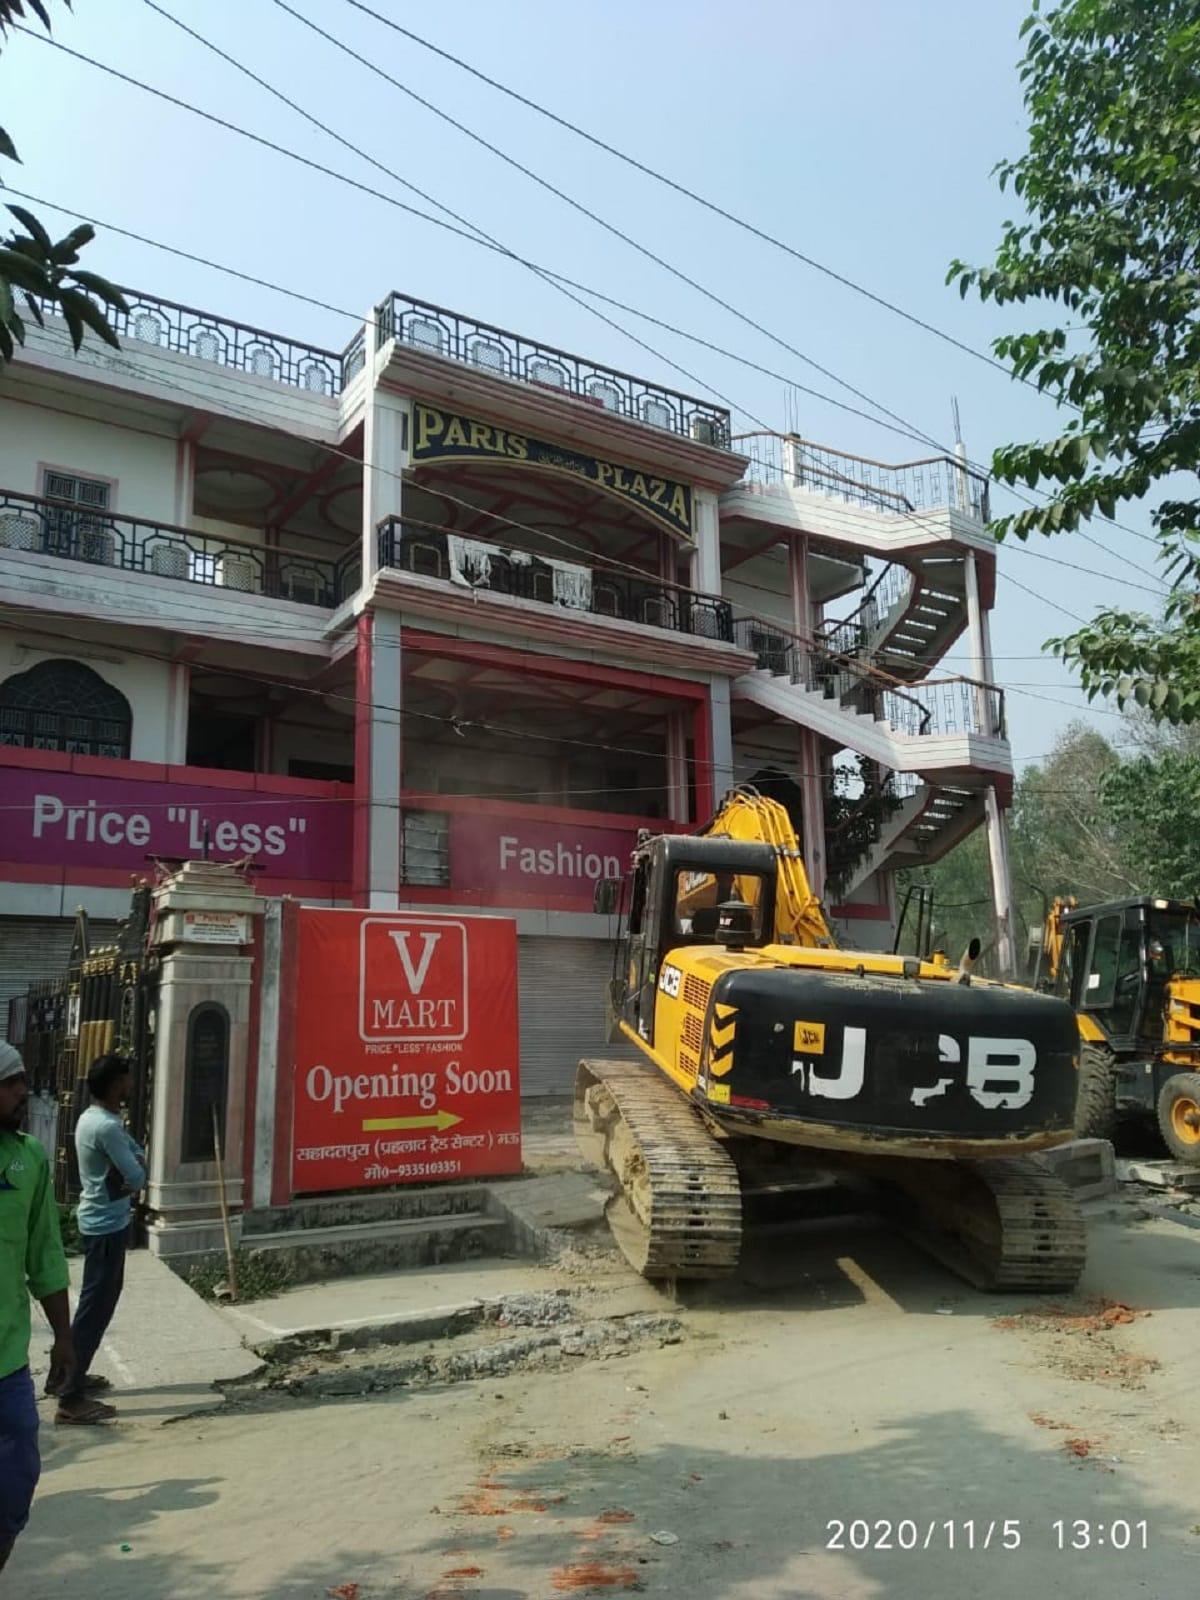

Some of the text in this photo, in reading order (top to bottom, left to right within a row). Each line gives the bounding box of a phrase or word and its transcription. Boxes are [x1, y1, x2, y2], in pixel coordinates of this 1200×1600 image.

[415, 405, 529, 459] PARIS
[594, 460, 690, 525] PLAZA
[33, 794, 306, 855] Price "Less"
[499, 835, 621, 880] Fashion
[388, 930, 442, 995] V
[371, 999, 456, 1029] MART
[365, 1044, 393, 1055] PRICE
[426, 1042, 463, 1053] FASHION
[306, 1061, 513, 1113] Opening Soon
